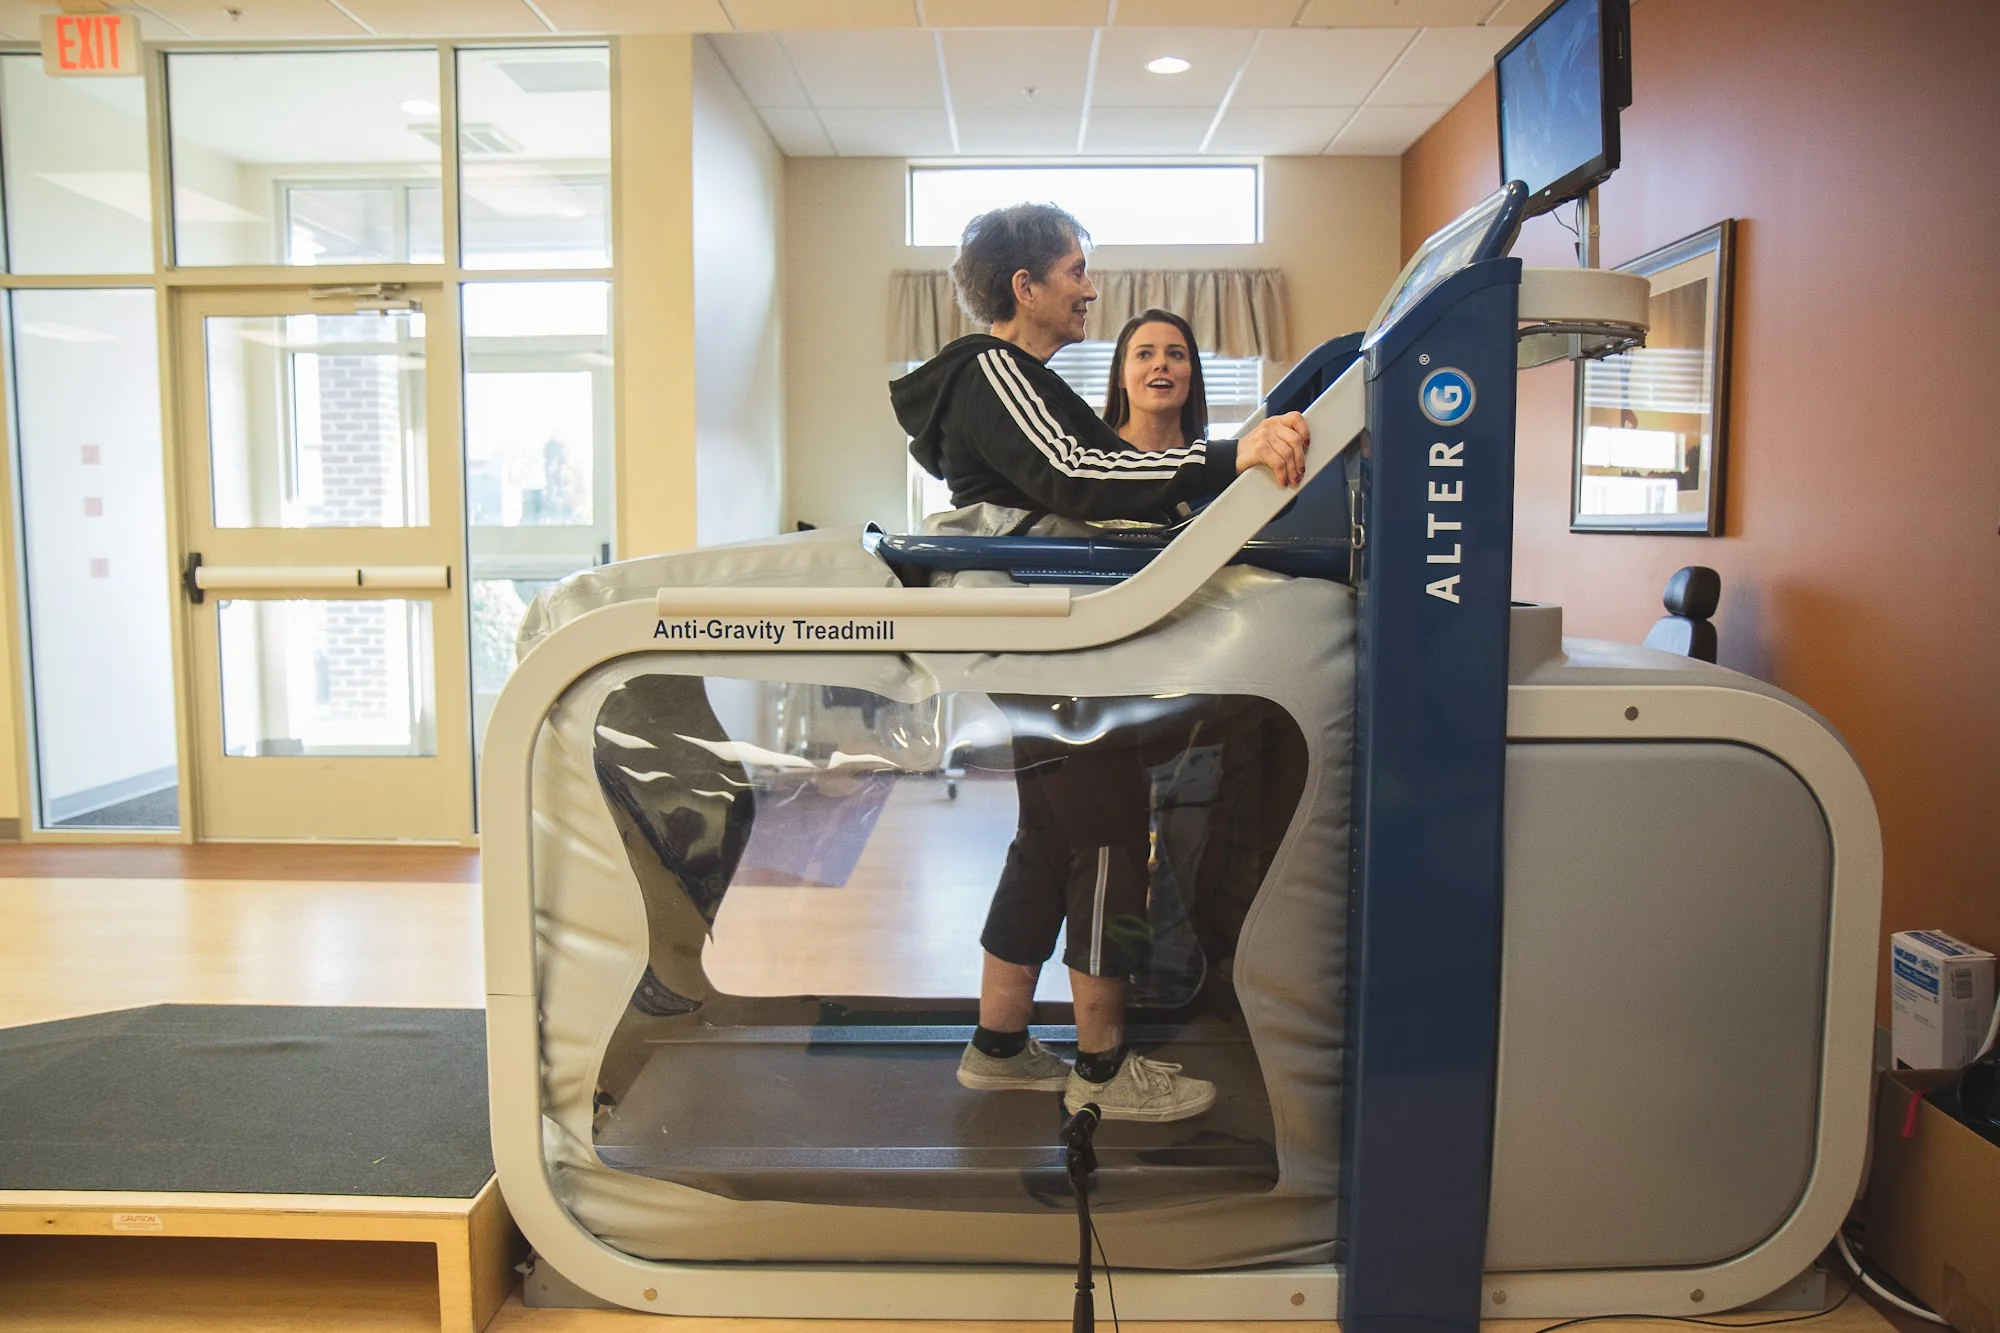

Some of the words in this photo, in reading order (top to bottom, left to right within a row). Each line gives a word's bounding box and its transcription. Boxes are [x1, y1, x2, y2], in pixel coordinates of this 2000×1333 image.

[55, 16, 122, 70] EXIT
[653, 619, 785, 644] Anti-Gravity
[792, 620, 894, 640] Treadmill
[120, 1214, 155, 1222] CAUTION
